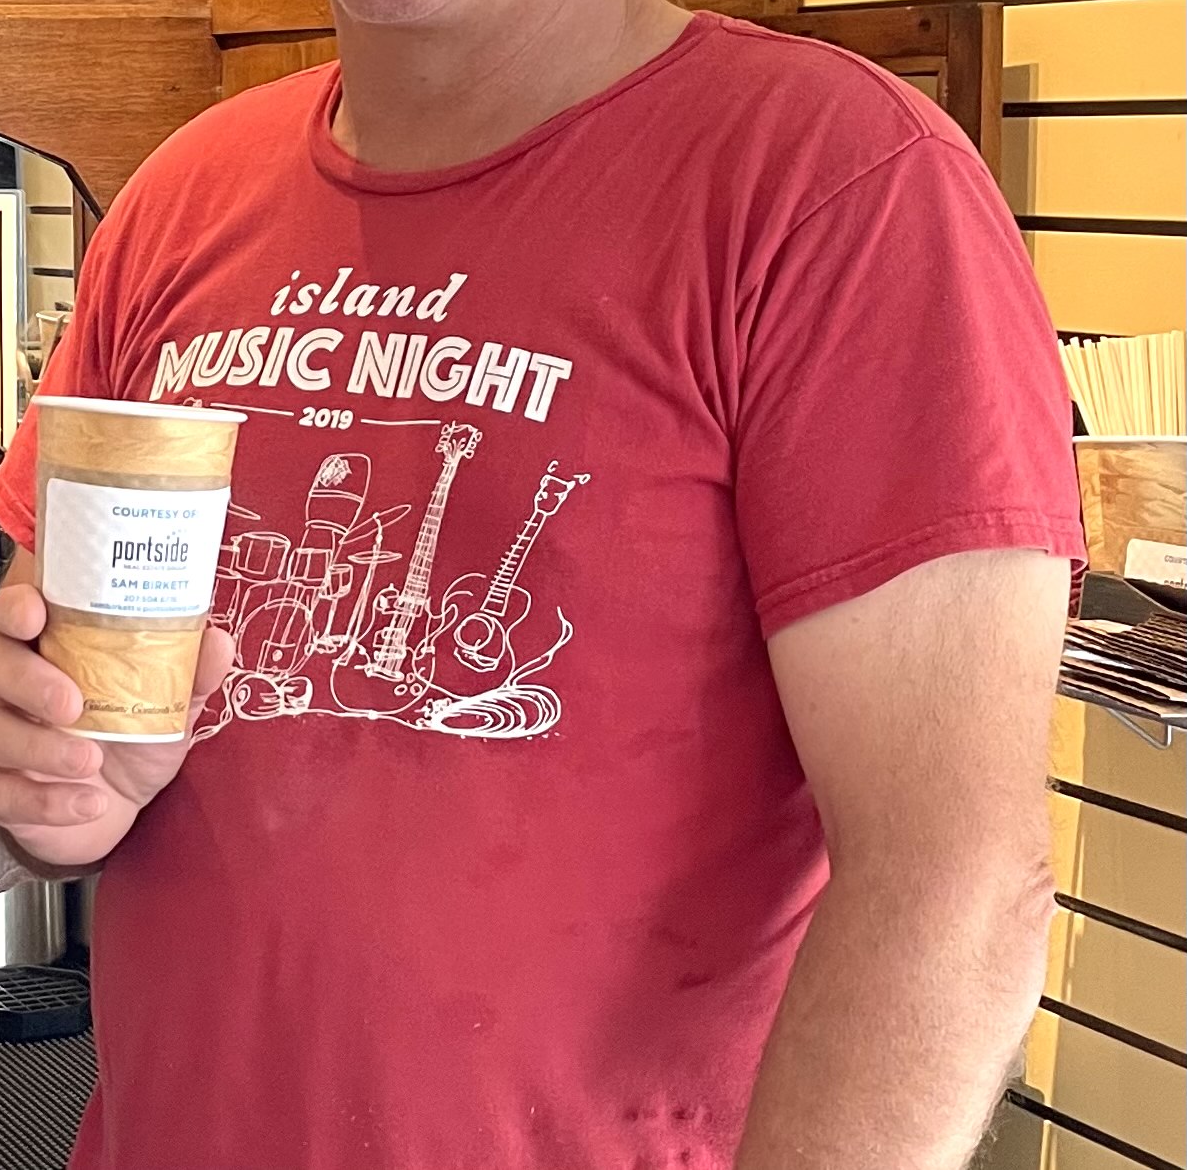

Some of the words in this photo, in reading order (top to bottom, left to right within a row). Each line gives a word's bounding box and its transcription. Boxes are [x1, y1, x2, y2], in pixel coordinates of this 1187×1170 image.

[270, 267, 469, 322] island
[149, 326, 345, 401] MUSIC
[347, 331, 573, 423] NIGHT
[299, 407, 354, 430] 2019
[112, 506, 179, 519] COURTESY
[182, 509, 198, 519] OF
[112, 535, 189, 568] portside
[111, 578, 138, 589] SAM
[142, 580, 189, 590] BIRKETT
